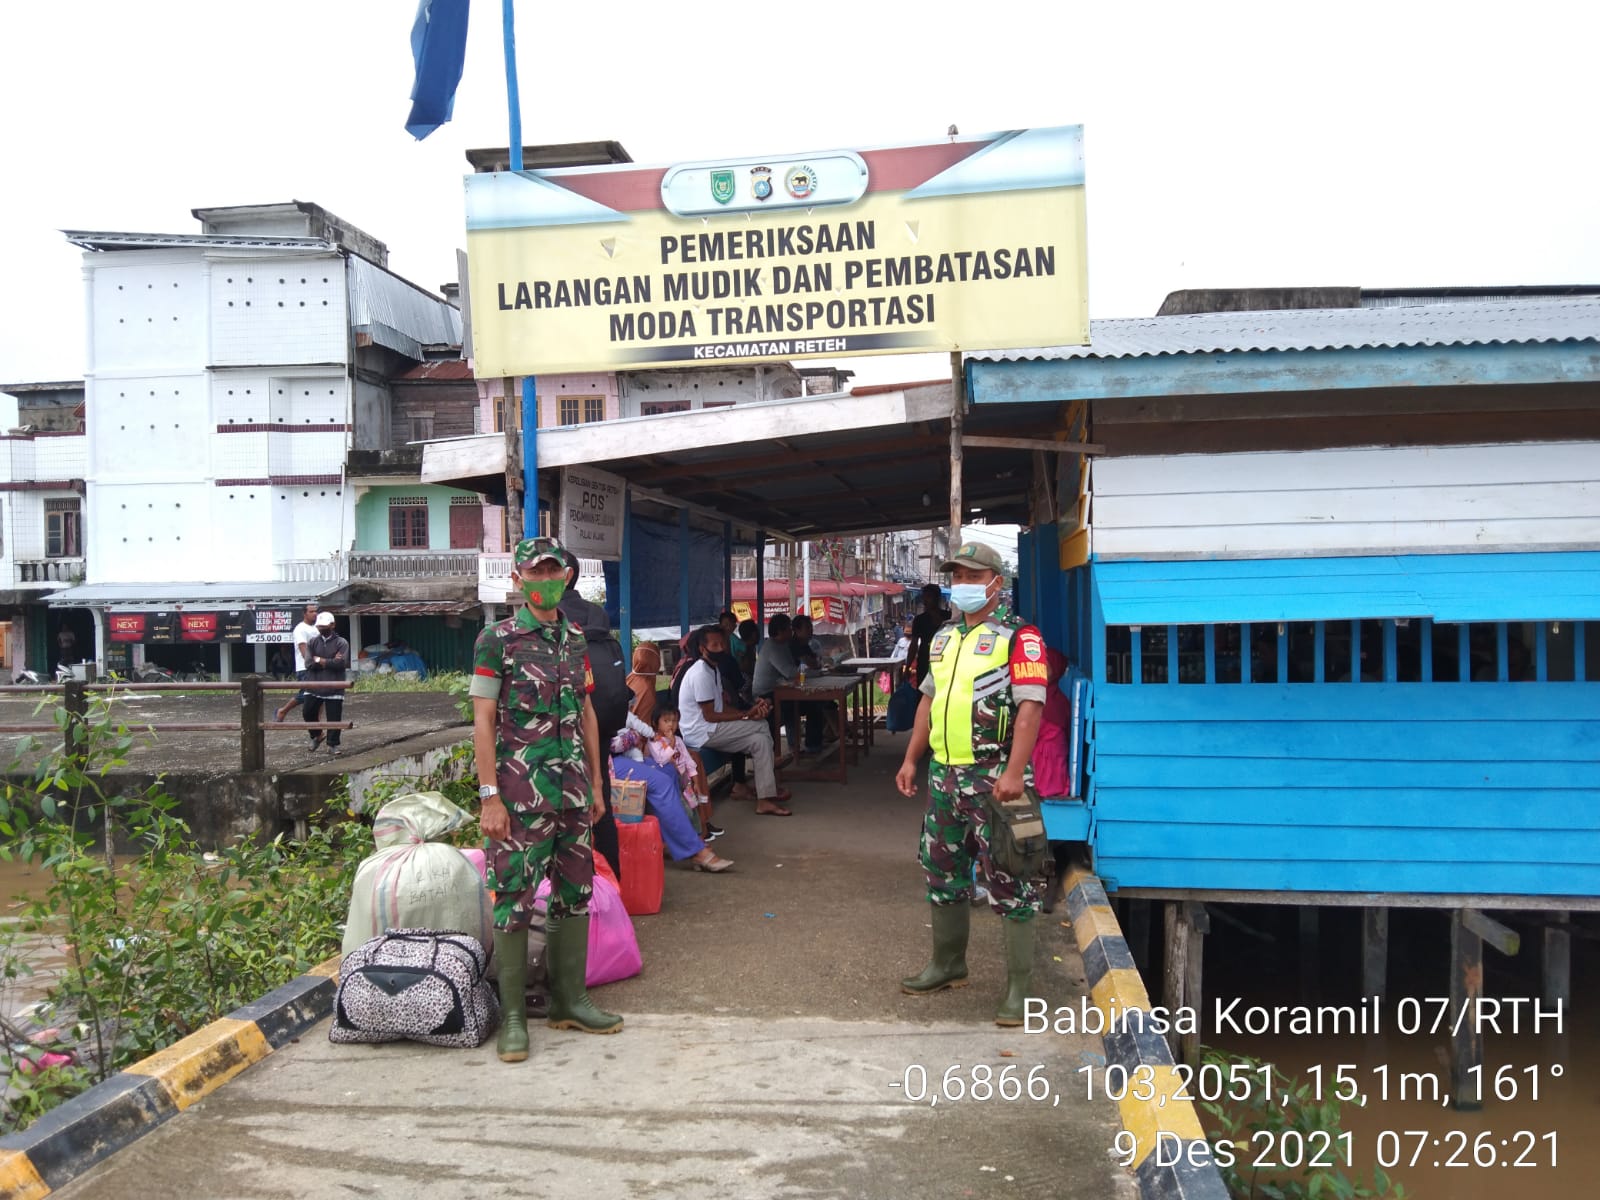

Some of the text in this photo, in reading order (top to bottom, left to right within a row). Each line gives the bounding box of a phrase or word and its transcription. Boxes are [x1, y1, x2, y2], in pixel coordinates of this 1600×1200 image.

[661, 223, 874, 264] PEMERIKSAAN
[499, 247, 1054, 312] LARANGAN MUDIK DAN PEMBATASAN
[610, 294, 934, 340] MODA TRANSPORTASI
[693, 338, 847, 359] KECAMATAN RETEH
[582, 491, 605, 510] POS
[116, 621, 138, 629] NEXT
[187, 620, 210, 628] NEXT
[255, 634, 282, 642] 25.000
